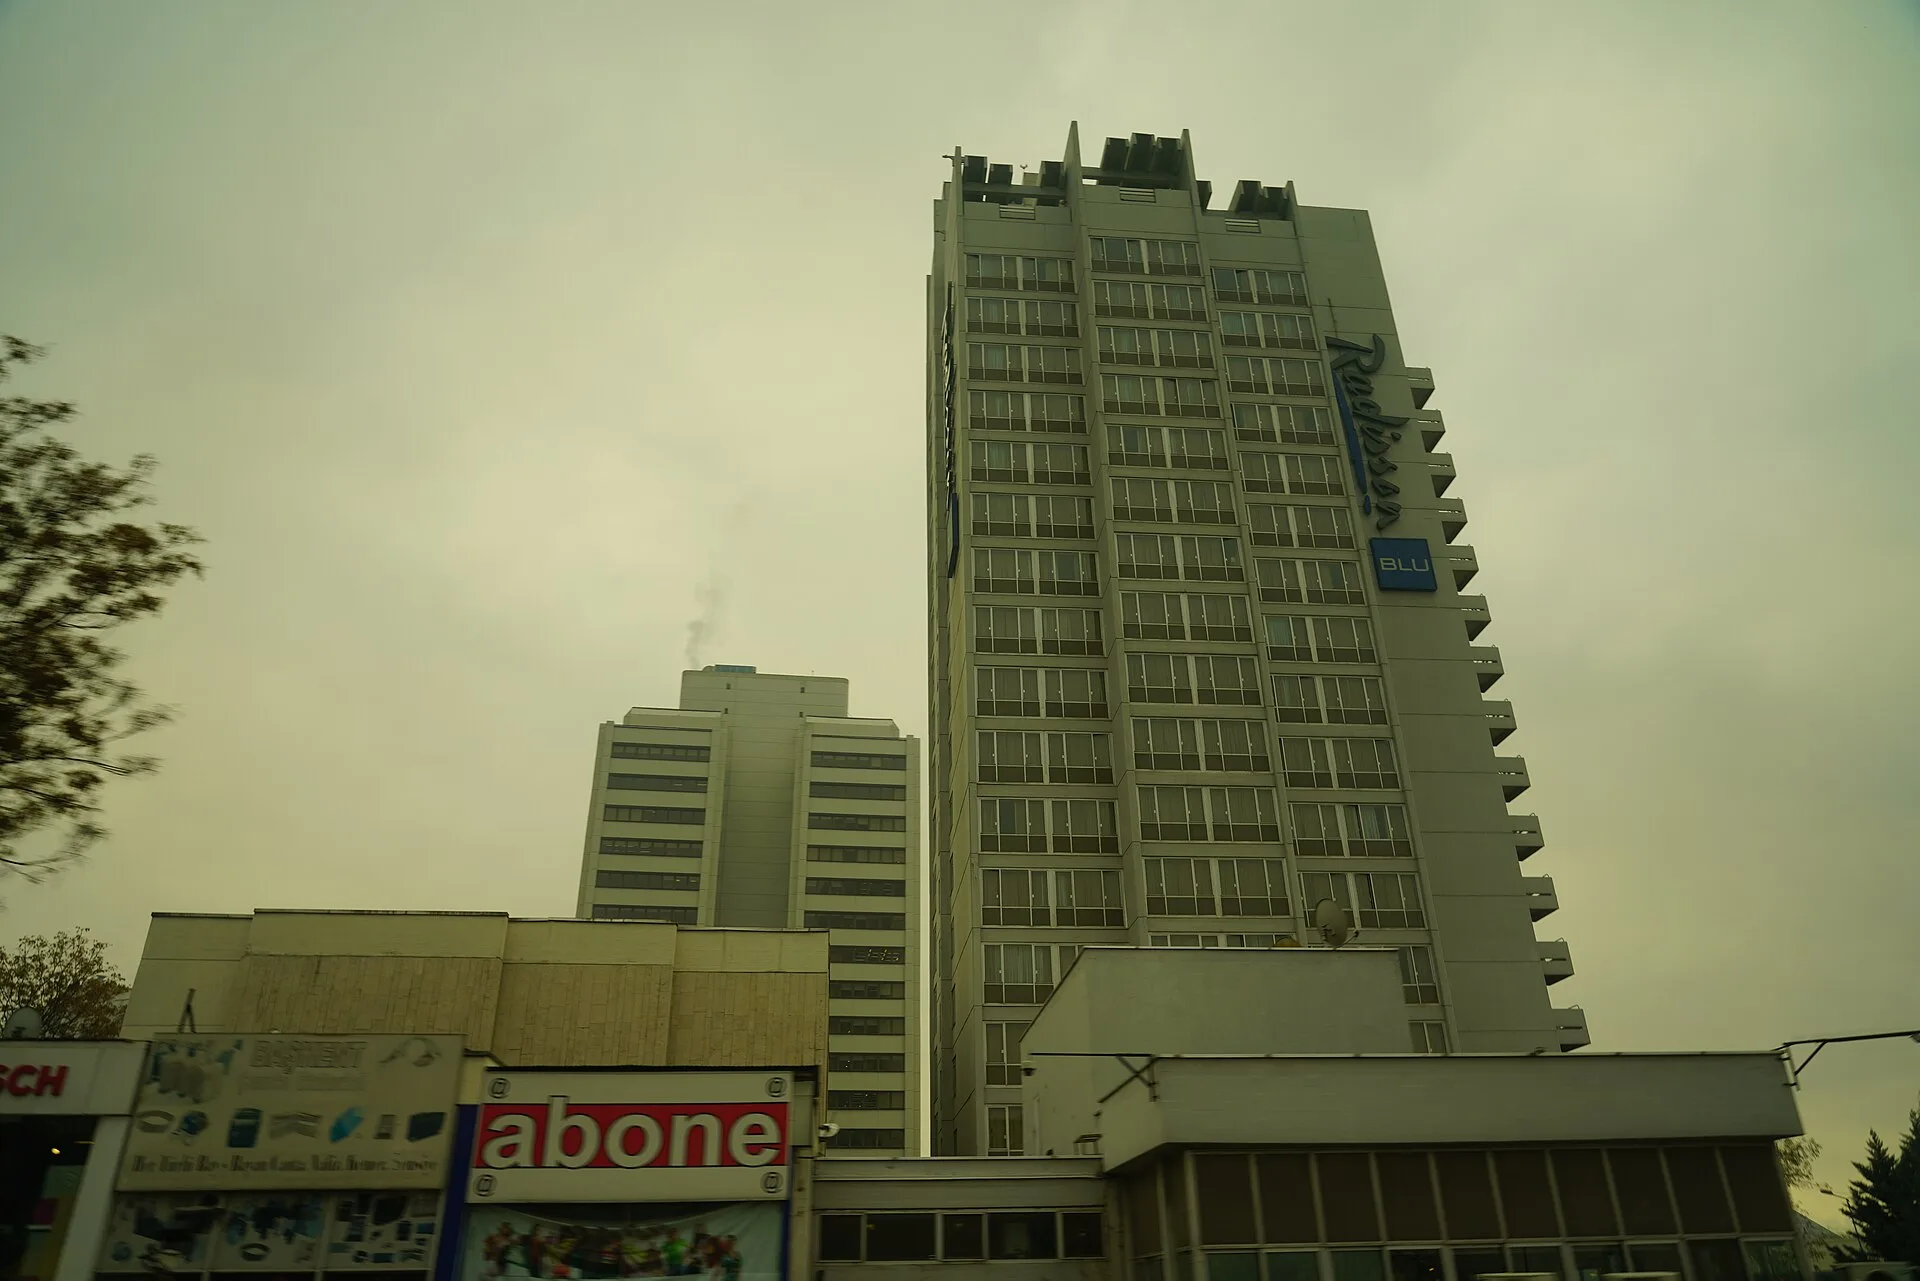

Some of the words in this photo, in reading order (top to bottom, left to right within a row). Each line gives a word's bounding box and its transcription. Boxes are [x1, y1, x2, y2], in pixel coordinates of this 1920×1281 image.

[1326, 334, 1409, 531] Radisson
[1379, 557, 1430, 572] BLU
[480, 1095, 781, 1169] abone
